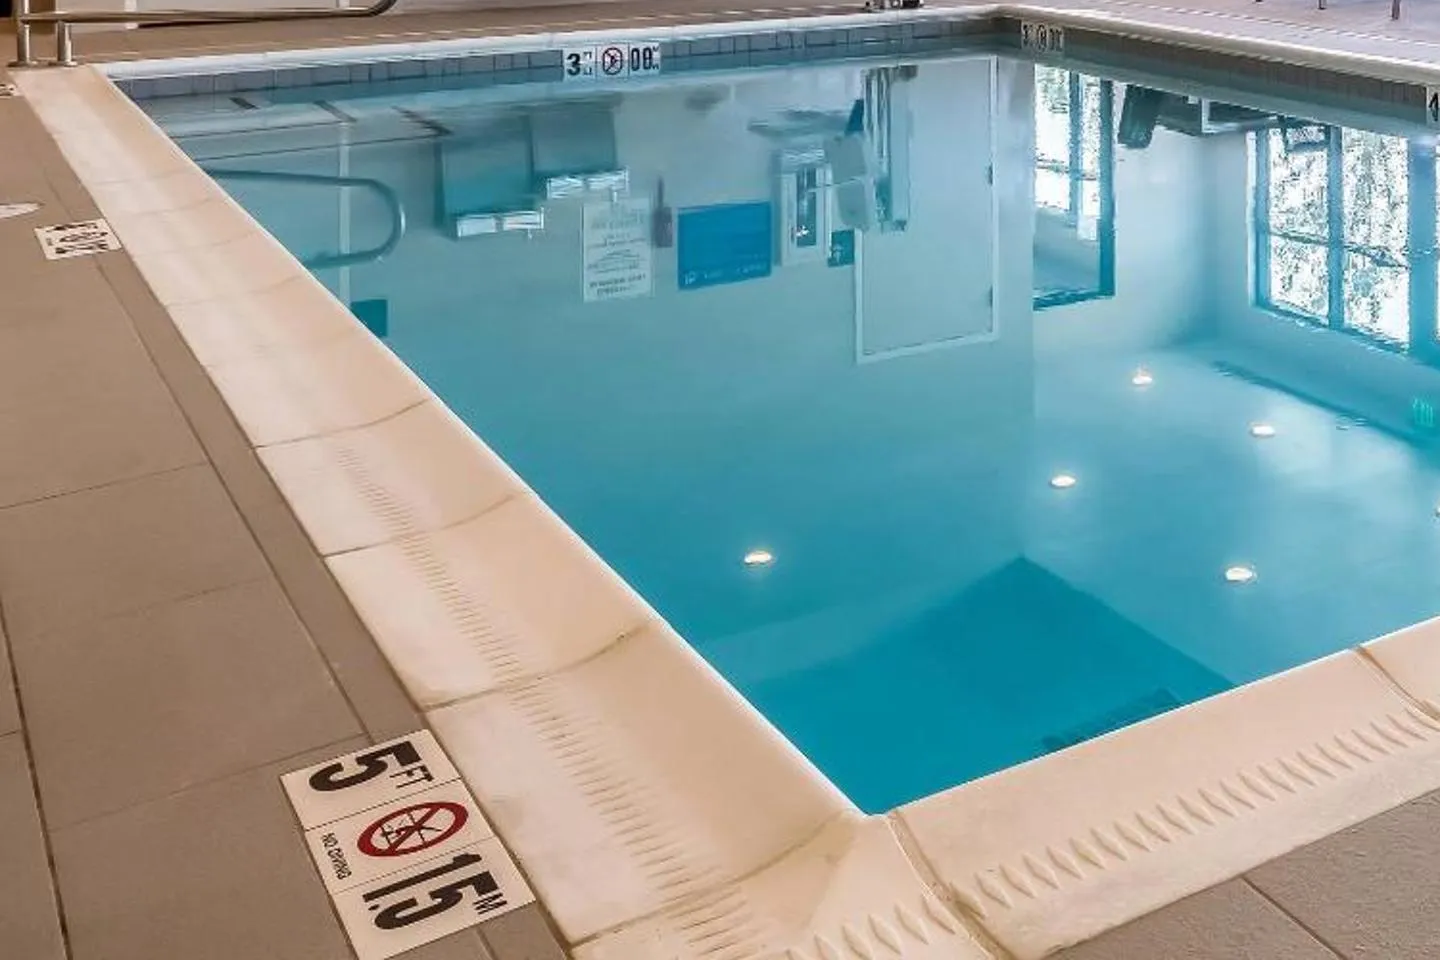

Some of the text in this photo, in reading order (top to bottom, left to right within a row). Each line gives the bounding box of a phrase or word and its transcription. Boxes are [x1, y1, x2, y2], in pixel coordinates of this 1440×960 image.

[309, 740, 433, 792] 5 FT
[321, 832, 352, 881] NO DIVING
[363, 852, 508, 930] 1.5 M
